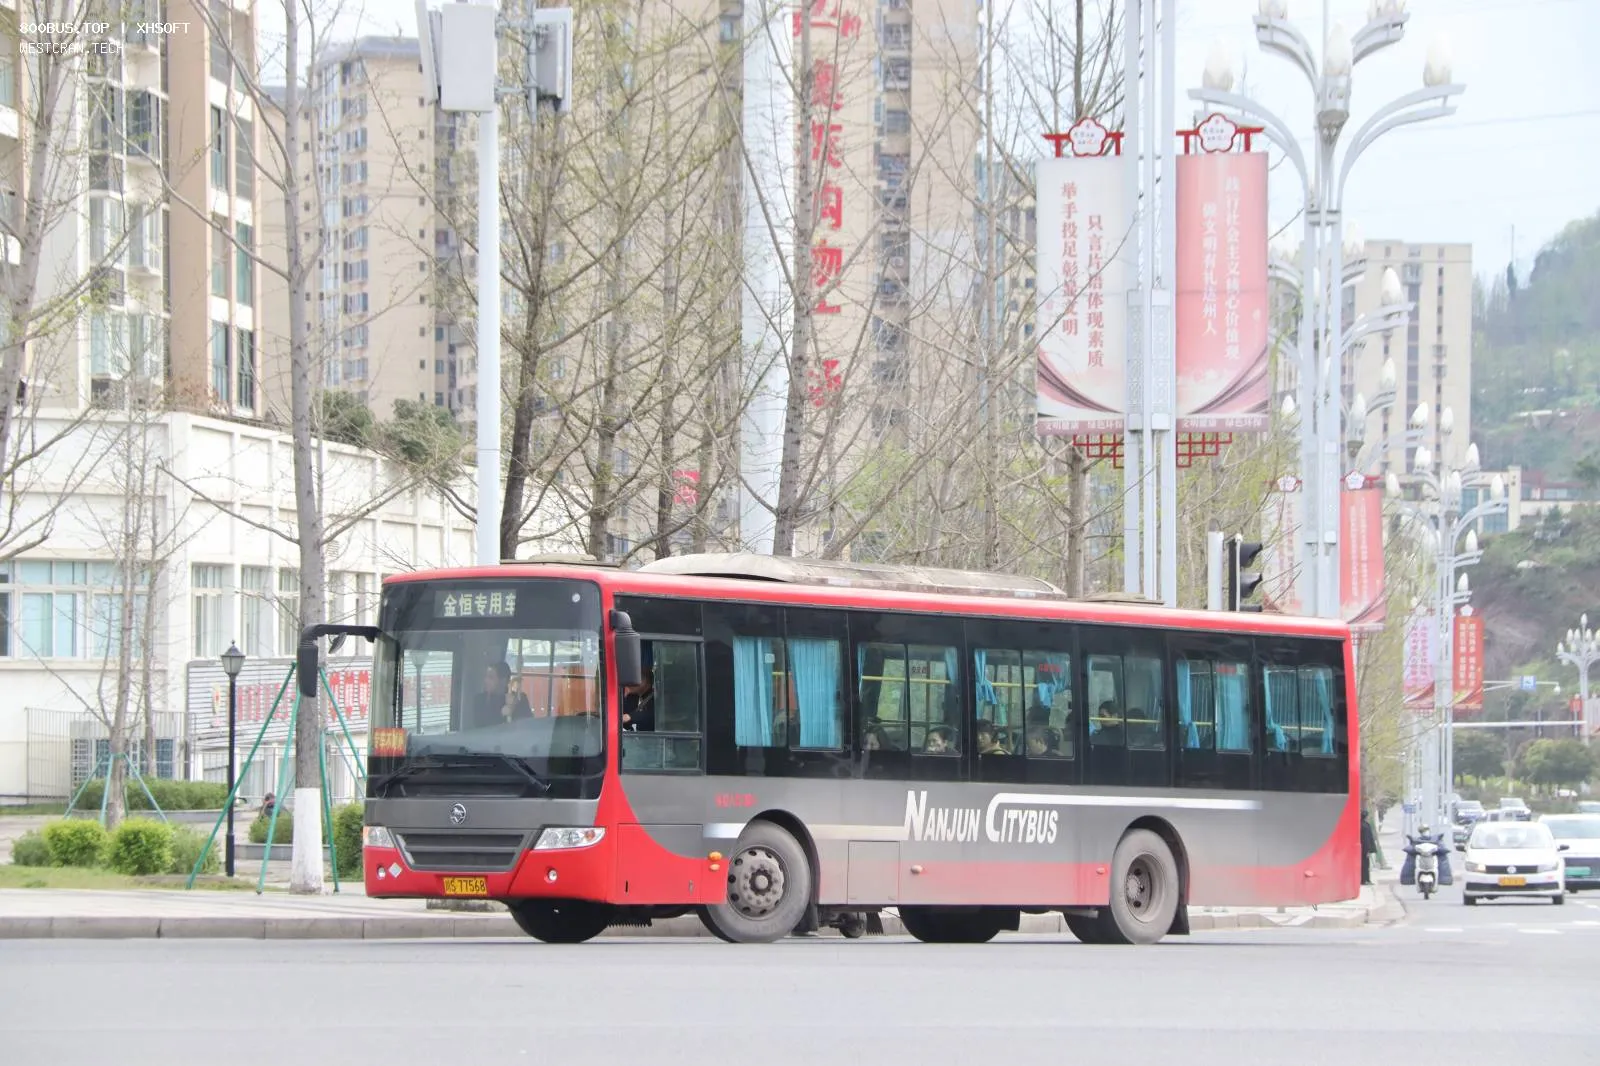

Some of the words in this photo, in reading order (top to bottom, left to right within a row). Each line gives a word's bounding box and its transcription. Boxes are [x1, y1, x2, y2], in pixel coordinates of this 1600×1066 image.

[1087, 213, 1105, 369] 只言片语体现素质
[443, 592, 516, 617] 金恒专用车
[904, 790, 980, 842] NANJUN
[985, 793, 1059, 844] CITYBUS
